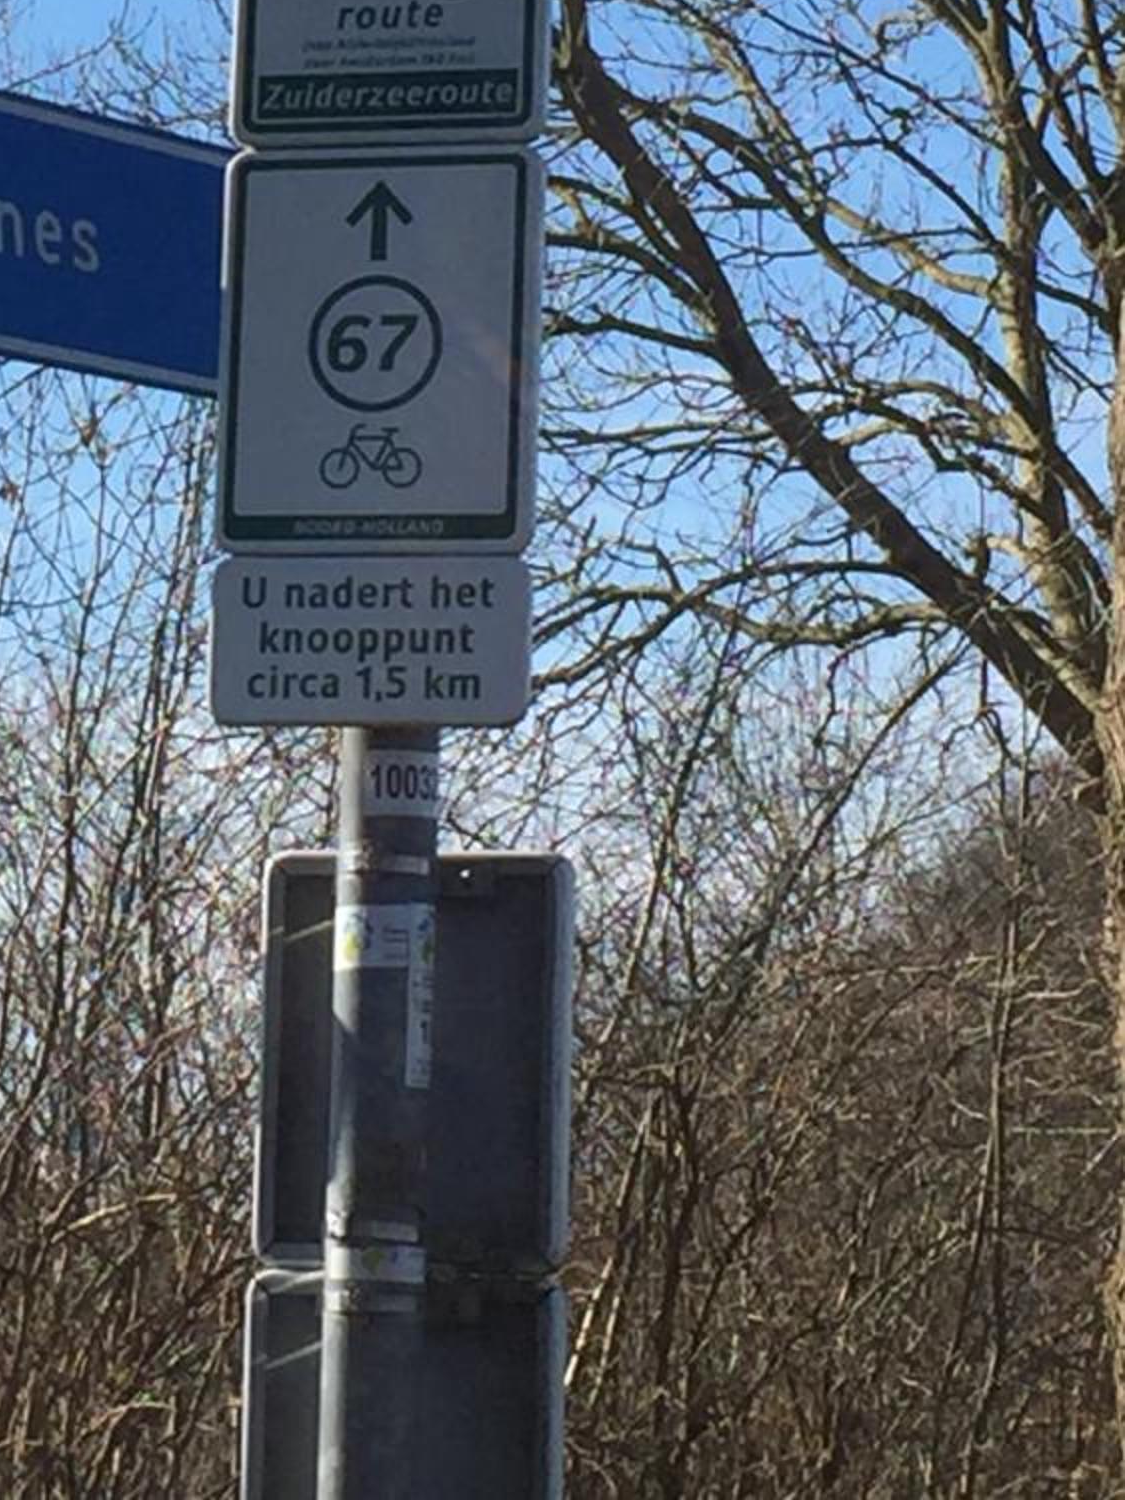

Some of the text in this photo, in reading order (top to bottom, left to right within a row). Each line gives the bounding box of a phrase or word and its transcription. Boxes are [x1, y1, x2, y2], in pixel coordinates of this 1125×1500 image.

[337, 0, 444, 30] route
[262, 77, 514, 111] Zuiderzeeroute
[326, 314, 420, 373] 67
[242, 575, 495, 609] U nadert het
[259, 621, 475, 663] knooppunt
[247, 664, 482, 703] circa 1,5 km
